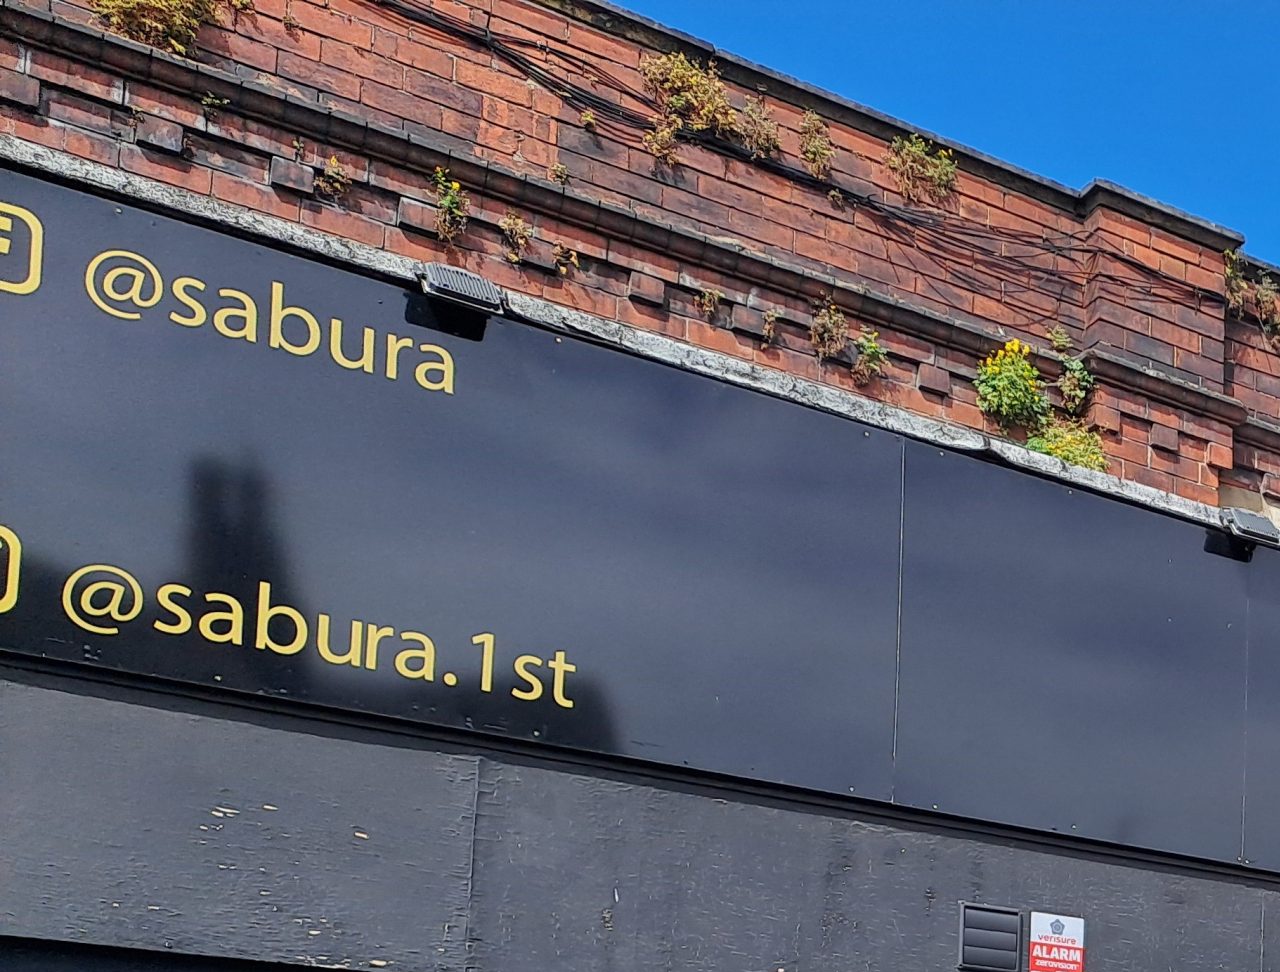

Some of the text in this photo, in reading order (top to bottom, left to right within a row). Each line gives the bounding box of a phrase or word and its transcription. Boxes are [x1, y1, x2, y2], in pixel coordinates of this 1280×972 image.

[84, 248, 457, 395] @sabura
[1037, 933, 1077, 945] verisure
[1032, 944, 1081, 962] ALARM
